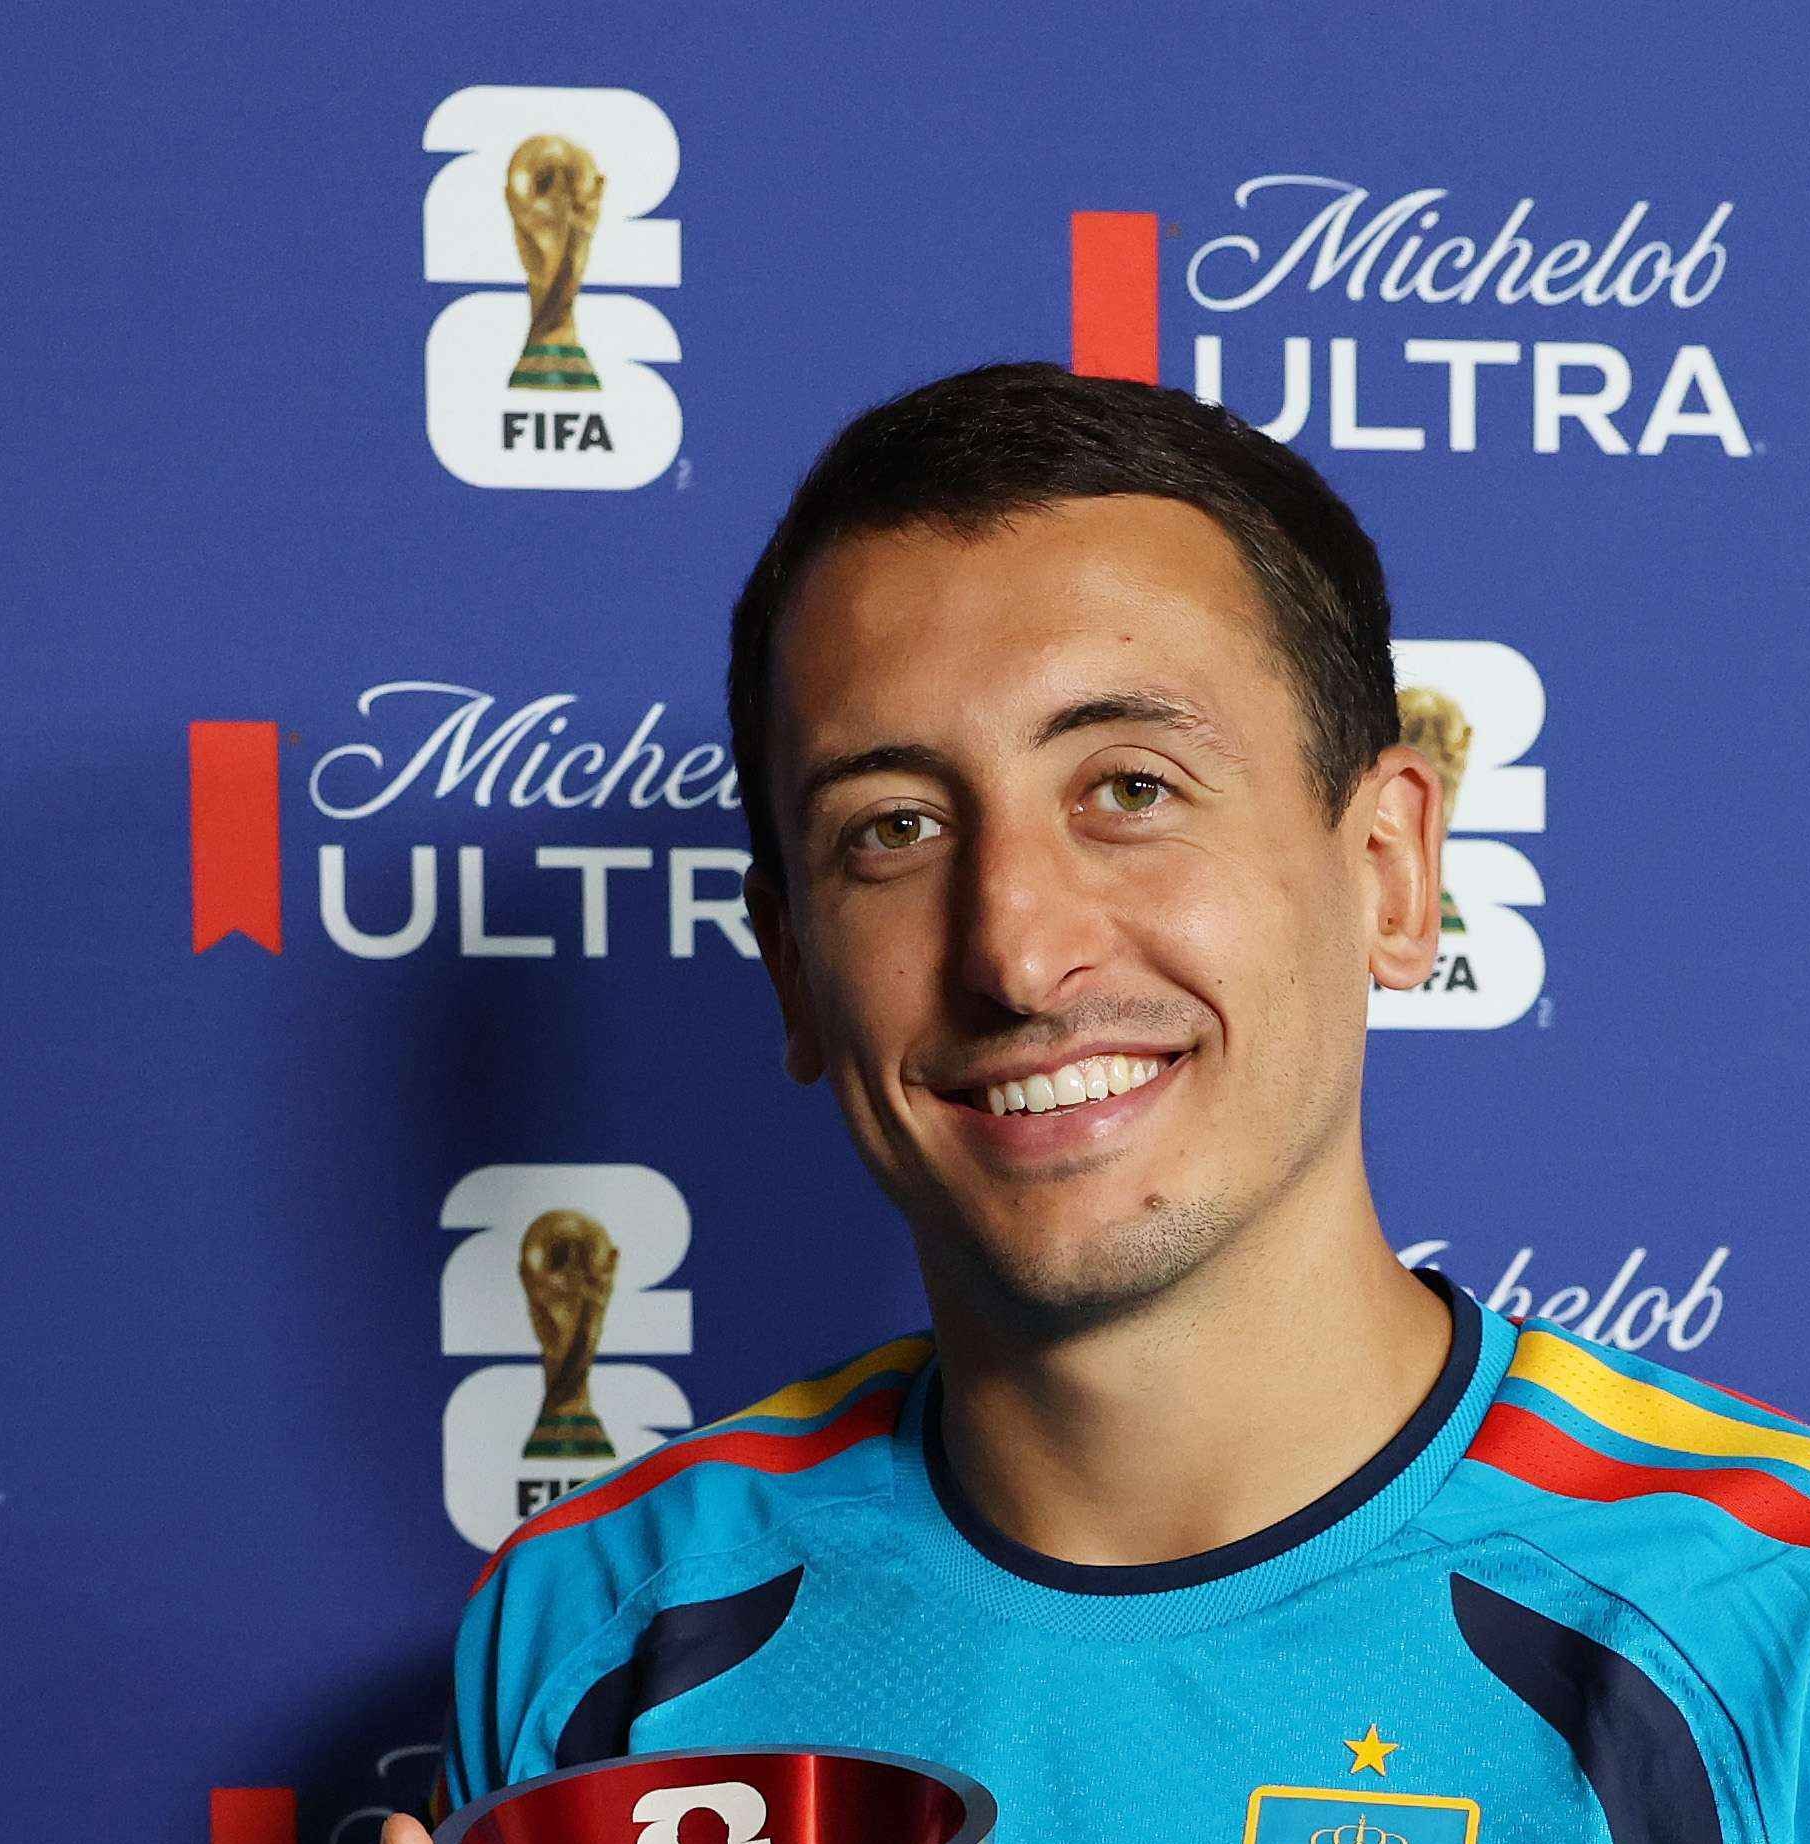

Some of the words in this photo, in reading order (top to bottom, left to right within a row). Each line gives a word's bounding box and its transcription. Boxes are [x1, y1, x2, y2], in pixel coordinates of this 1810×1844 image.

[1186, 174, 1734, 312] Michelob
[502, 411, 614, 452] FIFA
[1396, 1239, 1731, 1352] helob
